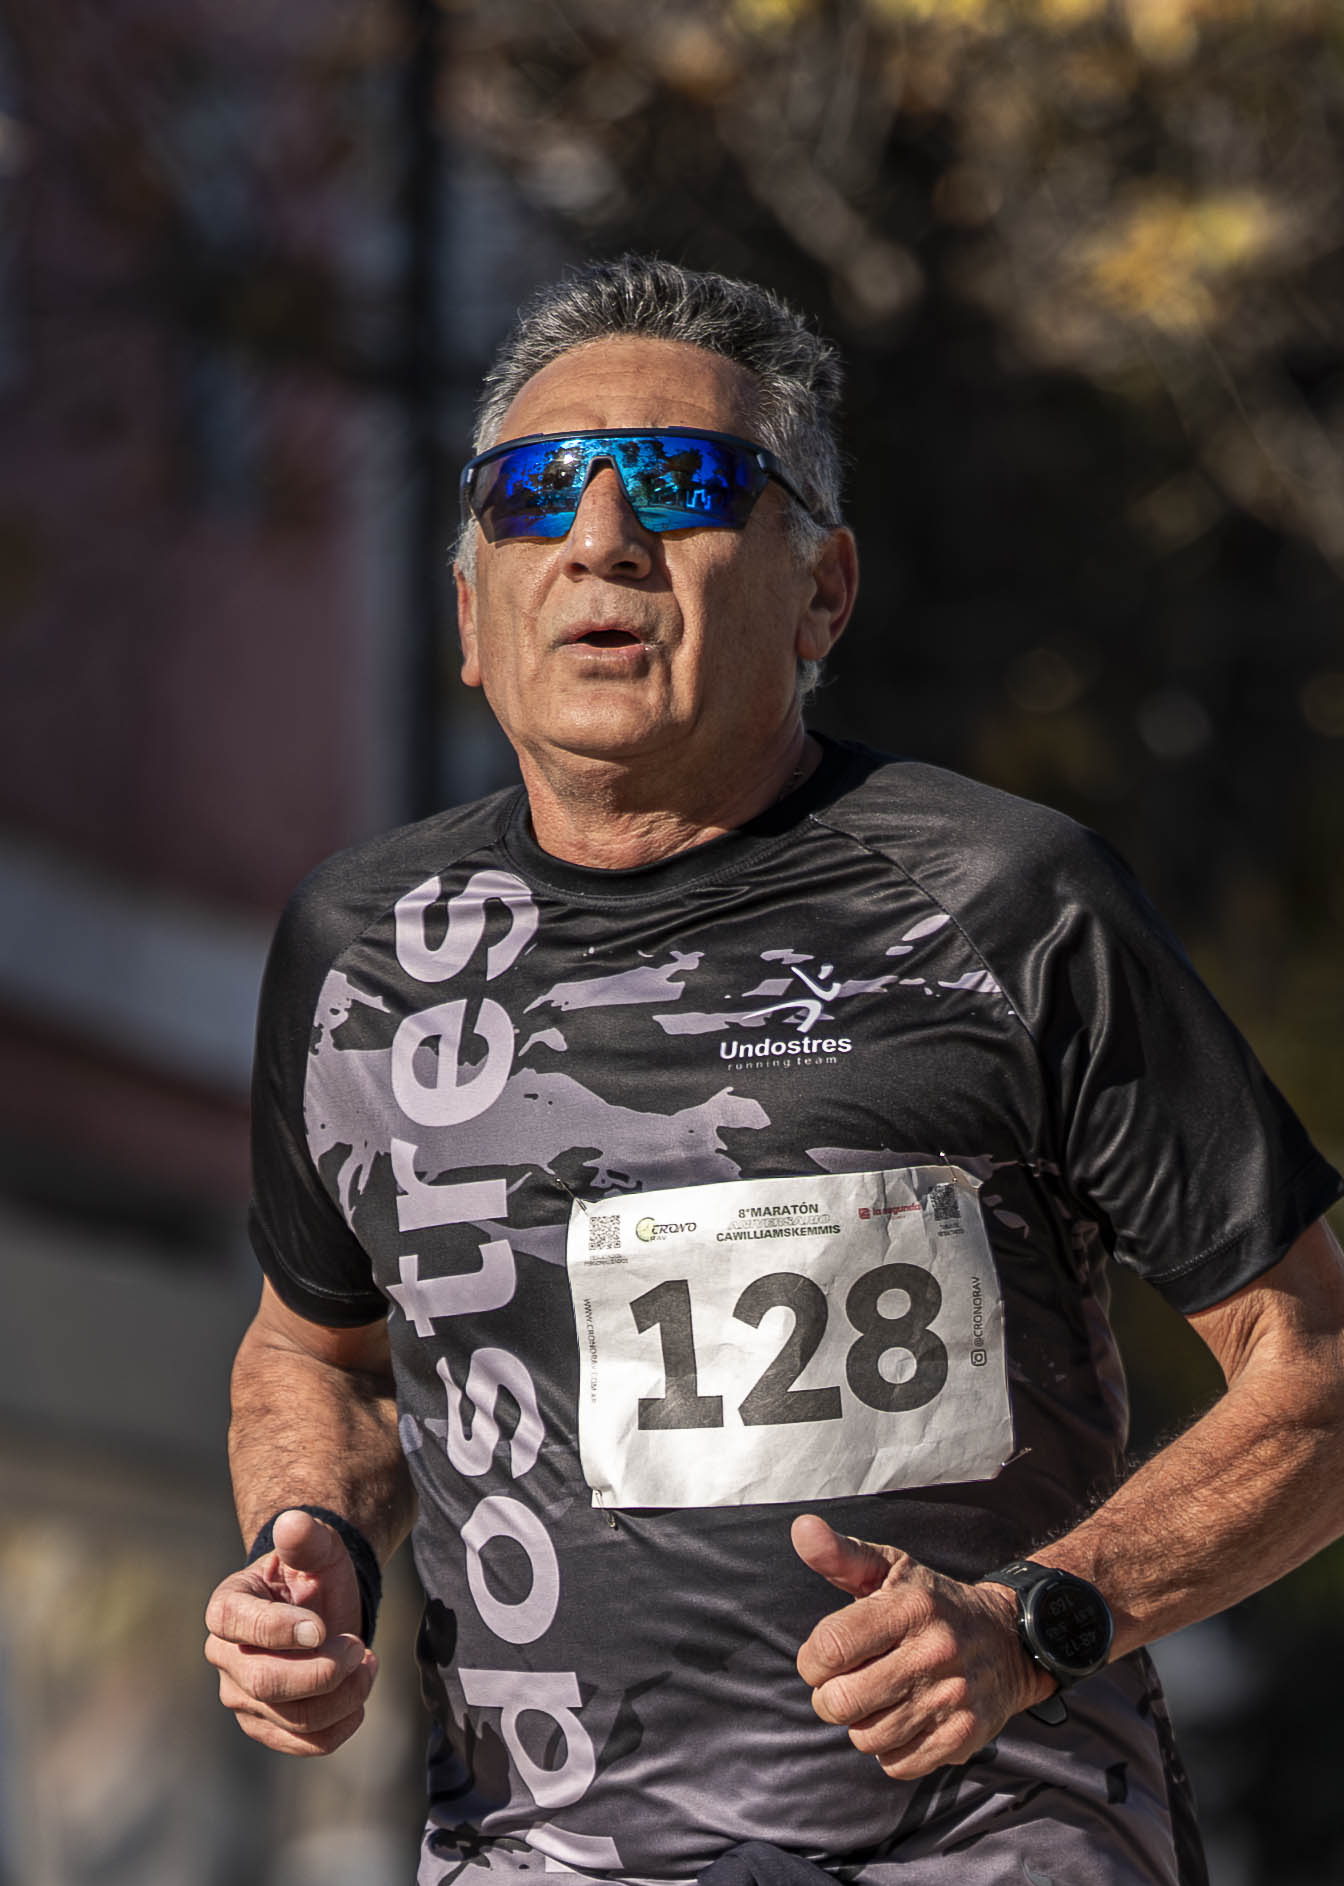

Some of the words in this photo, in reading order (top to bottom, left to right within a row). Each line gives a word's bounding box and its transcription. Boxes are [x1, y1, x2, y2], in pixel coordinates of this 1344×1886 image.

[719, 1036, 853, 1060] Undostres
[727, 1059, 791, 1071] running
[797, 1056, 837, 1066] team
[716, 1224, 841, 1242] CAWILLIAMSKEMMIS
[971, 1275, 984, 1347] @CRONORAV
[629, 1262, 949, 1432] 128
